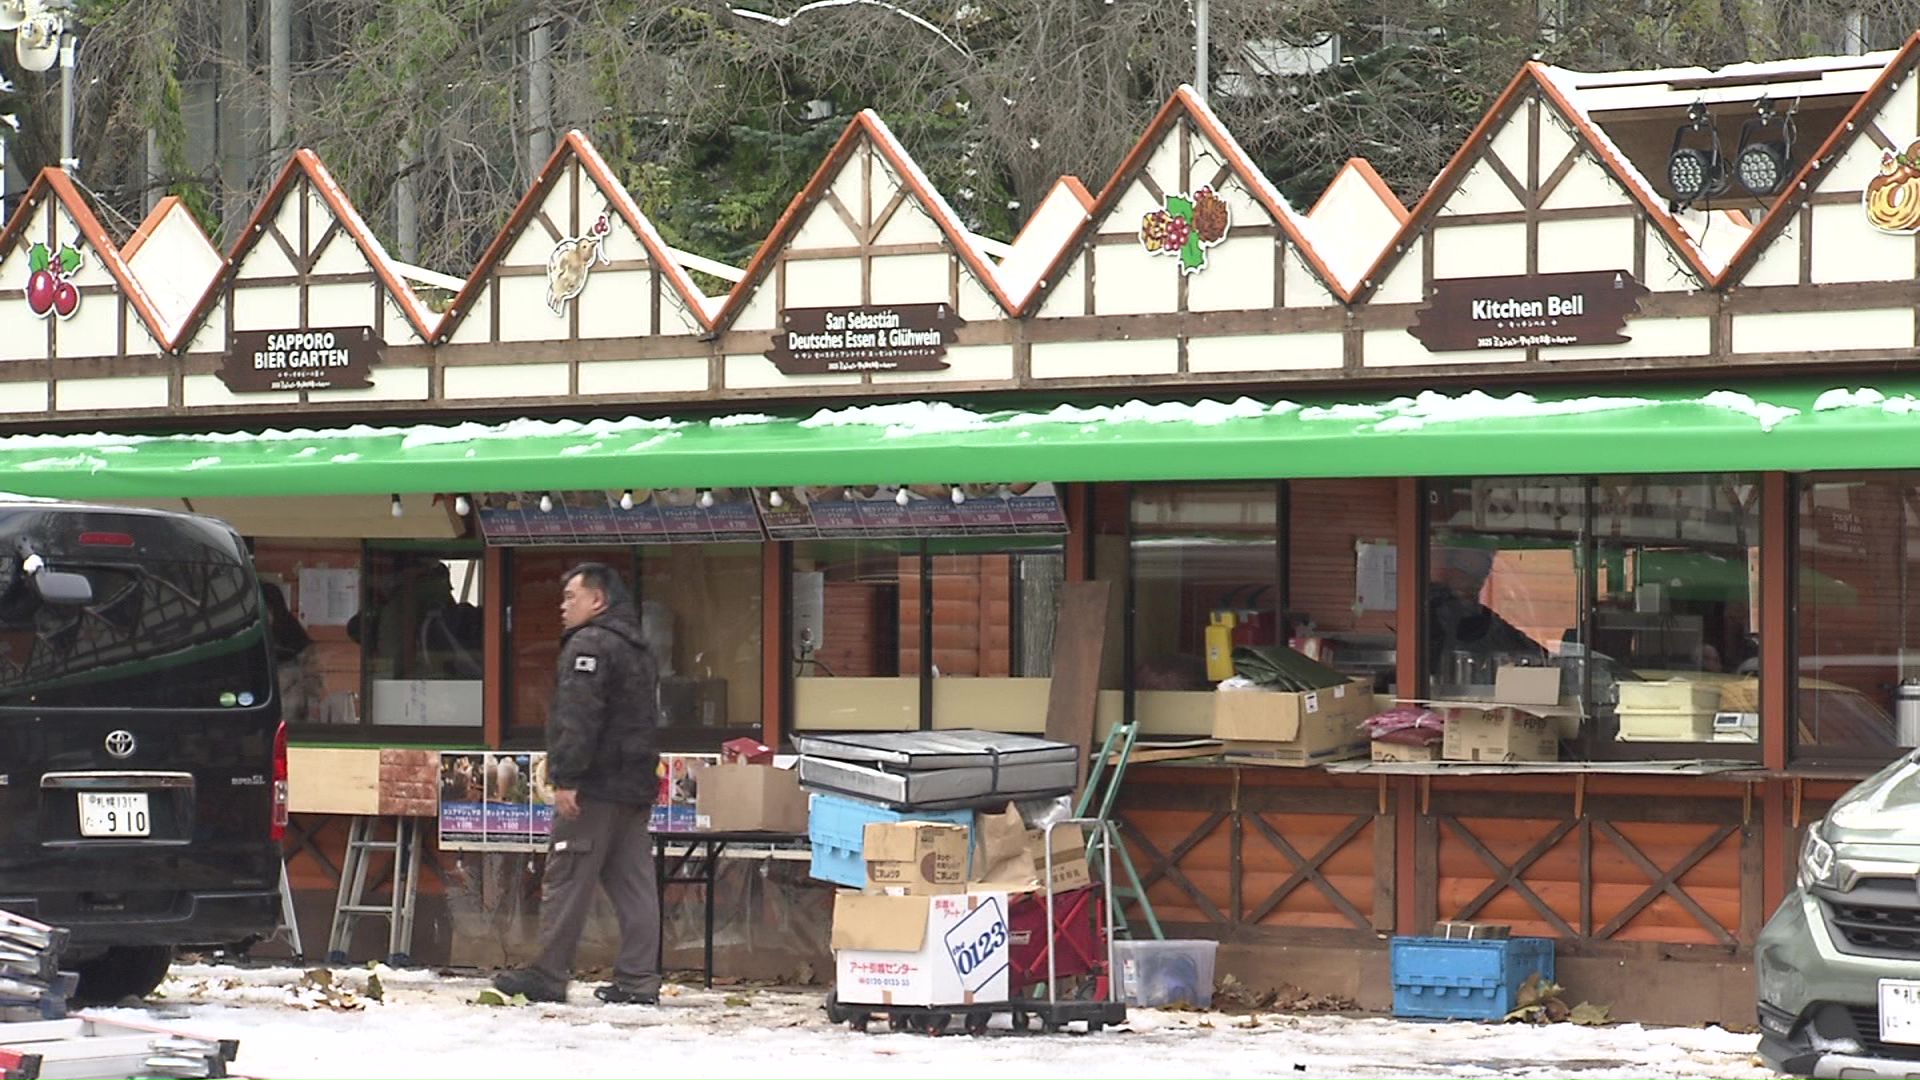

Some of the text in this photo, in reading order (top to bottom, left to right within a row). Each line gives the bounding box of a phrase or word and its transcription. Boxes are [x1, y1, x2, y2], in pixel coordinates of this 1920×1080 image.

[1472, 294, 1584, 320] Kitchen Bell
[825, 309, 899, 330] San Sebastián
[267, 332, 335, 351] SAPPORO
[788, 328, 941, 350] Deutsches Essen & Glühwein
[254, 349, 349, 369] BIER GARTEN
[958, 921, 1006, 975] 0123
